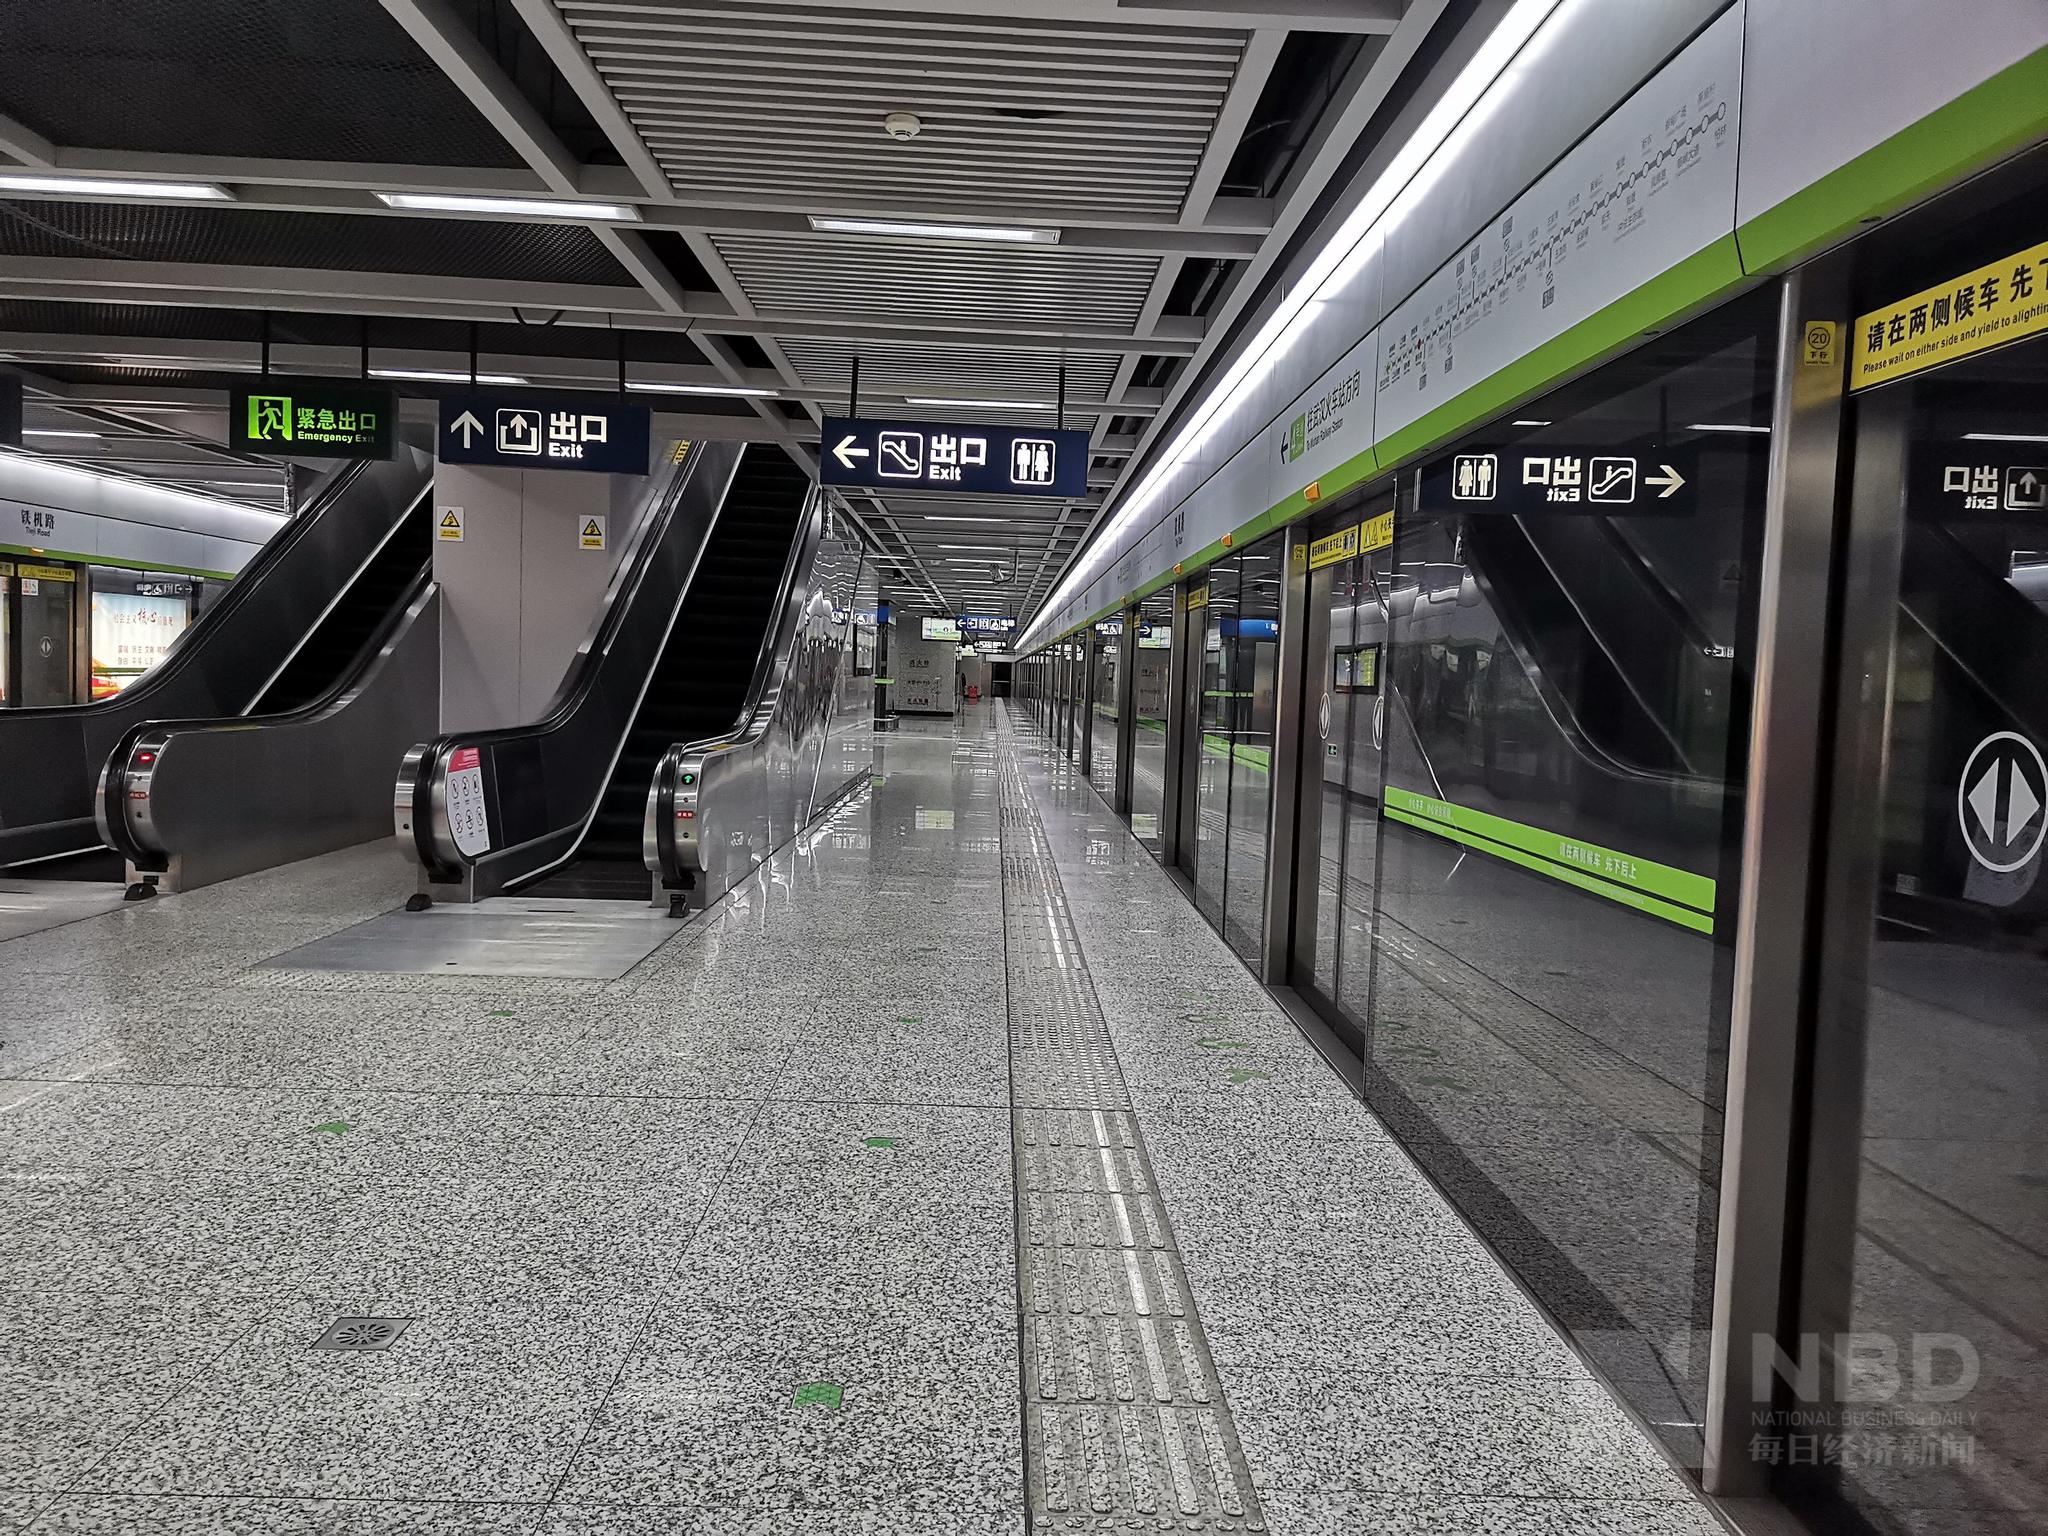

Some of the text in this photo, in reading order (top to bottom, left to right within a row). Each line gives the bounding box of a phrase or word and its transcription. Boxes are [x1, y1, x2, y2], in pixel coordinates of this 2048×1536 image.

[1867, 277, 2000, 353] 请在两侧候车
[1811, 333, 1827, 344] 20
[1863, 359, 1887, 374] Please
[1889, 351, 1904, 366] wait
[1905, 351, 1915, 361] on
[1916, 340, 1939, 357] either
[1940, 333, 1958, 348] side
[1960, 326, 1976, 342] and
[1977, 320, 1999, 339] yield
[2001, 316, 2010, 327] to
[297, 407, 376, 432] 紧急出口
[549, 411, 608, 443] 出口
[297, 431, 375, 444] Emergency Exit
[548, 442, 585, 459] Exit
[930, 433, 987, 466] 出口
[929, 464, 961, 481] Exit
[20, 508, 55, 530] 铁机路
[37, 527, 51, 538] Road
[1605, 856, 1636, 880] 先下后上
